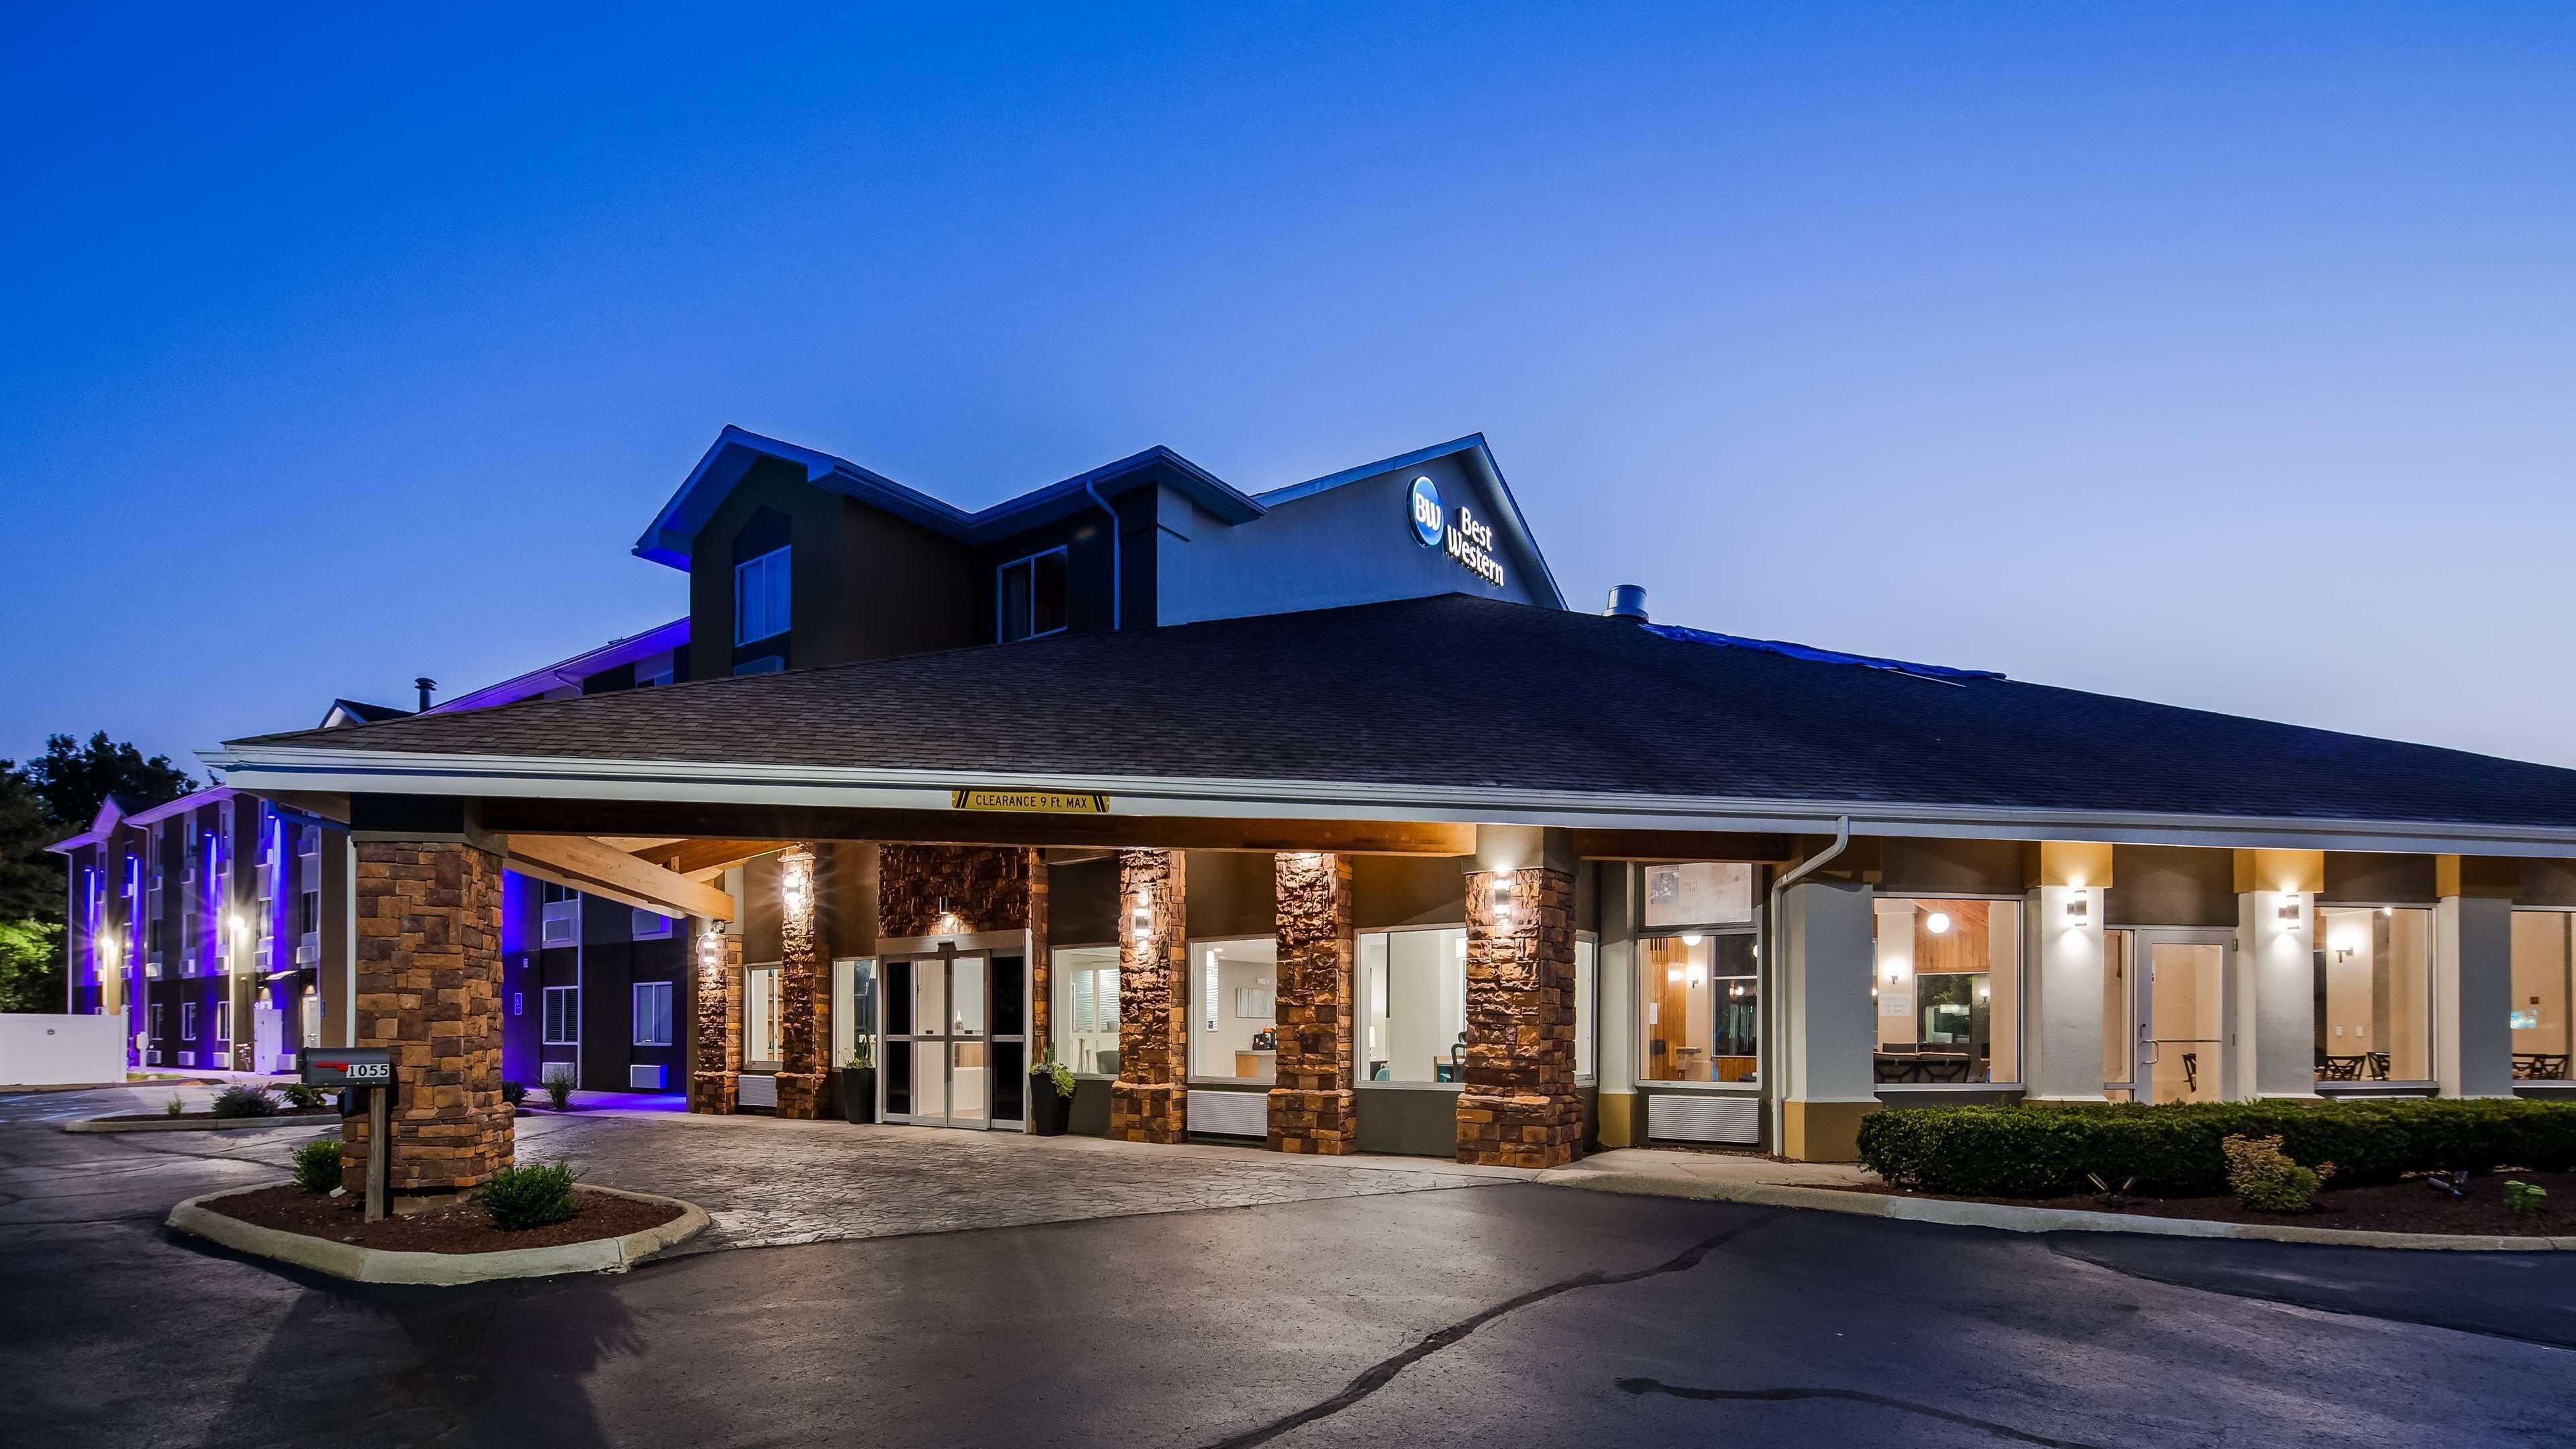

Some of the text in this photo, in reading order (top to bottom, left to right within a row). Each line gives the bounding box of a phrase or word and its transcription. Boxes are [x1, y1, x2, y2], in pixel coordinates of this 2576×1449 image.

[1415, 492, 1441, 531] BW
[1462, 506, 1493, 551] Best
[1447, 524, 1504, 586] Western
[975, 794, 1087, 808] CLEARANCE 9 Ft. MAX
[349, 1065, 388, 1077] 1055
